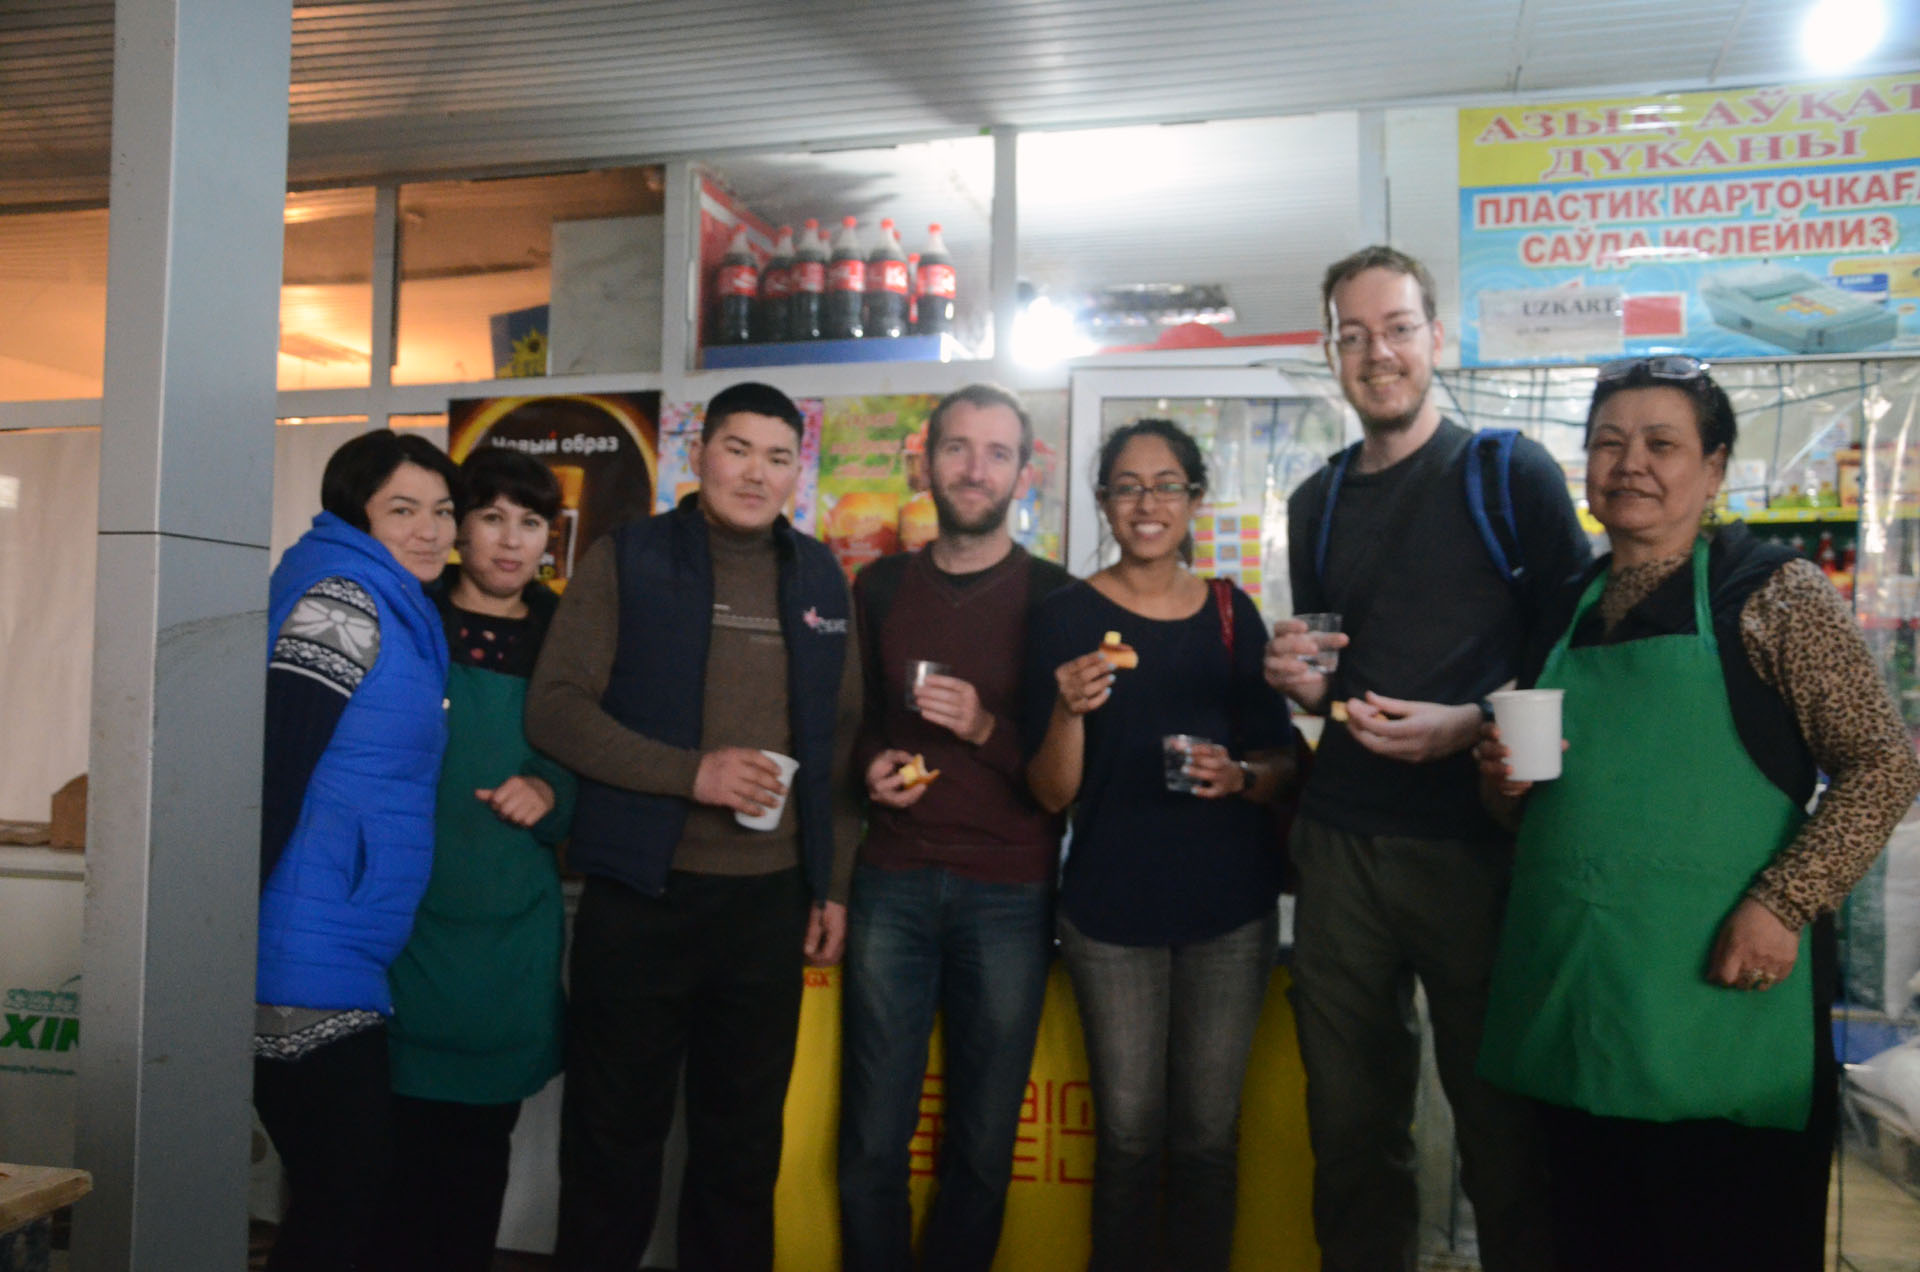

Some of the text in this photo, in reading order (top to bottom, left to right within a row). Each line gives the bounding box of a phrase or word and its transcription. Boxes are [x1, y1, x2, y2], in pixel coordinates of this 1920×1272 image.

[1478, 188, 1659, 226] ПЛАСТИК
[1663, 215, 1894, 258] ИСЛЕЙМИЗ
[561, 433, 618, 456] образ
